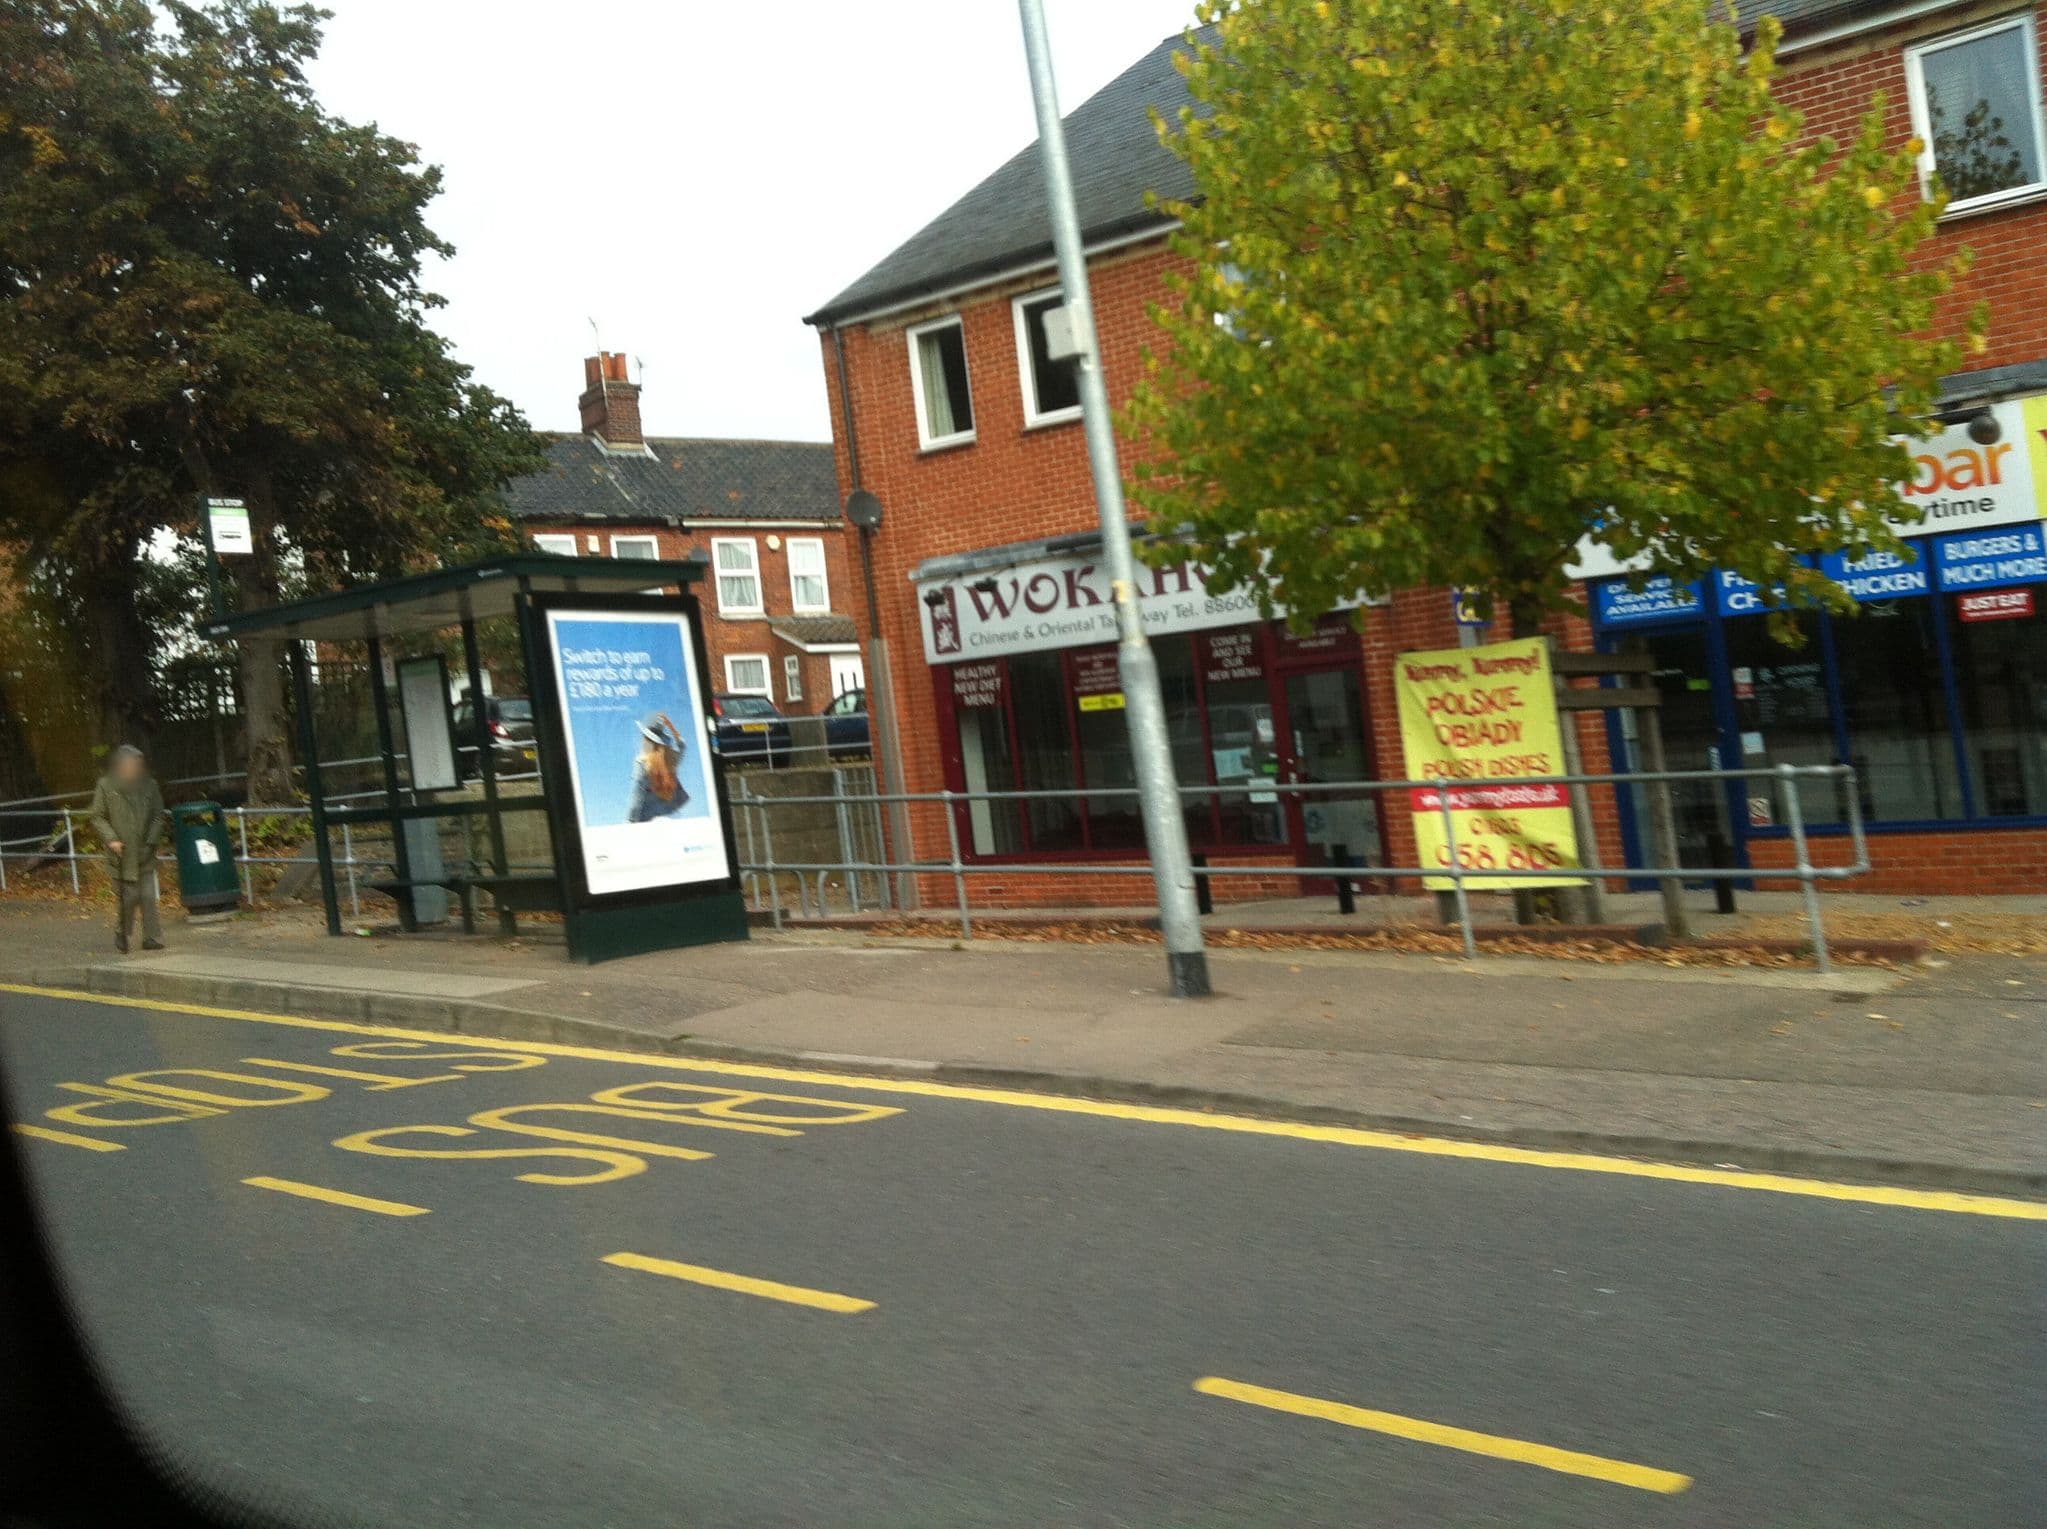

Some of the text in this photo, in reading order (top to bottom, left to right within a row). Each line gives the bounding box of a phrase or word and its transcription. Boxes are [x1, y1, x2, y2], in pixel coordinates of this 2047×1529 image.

[1944, 533, 2040, 560] BURGERS &
[1840, 570, 1927, 596] HICKEN
[1942, 556, 2047, 584] MUCH MORE
[1960, 593, 2029, 611] JUST EAT
[970, 631, 1019, 648] Chinese
[1024, 625, 1035, 639] &
[1039, 615, 1096, 638] Oriental
[1175, 602, 1199, 619] Tel.
[953, 665, 997, 680] HEALTHY
[1232, 666, 1262, 678] MENU
[332, 1081, 908, 1188] BUS
